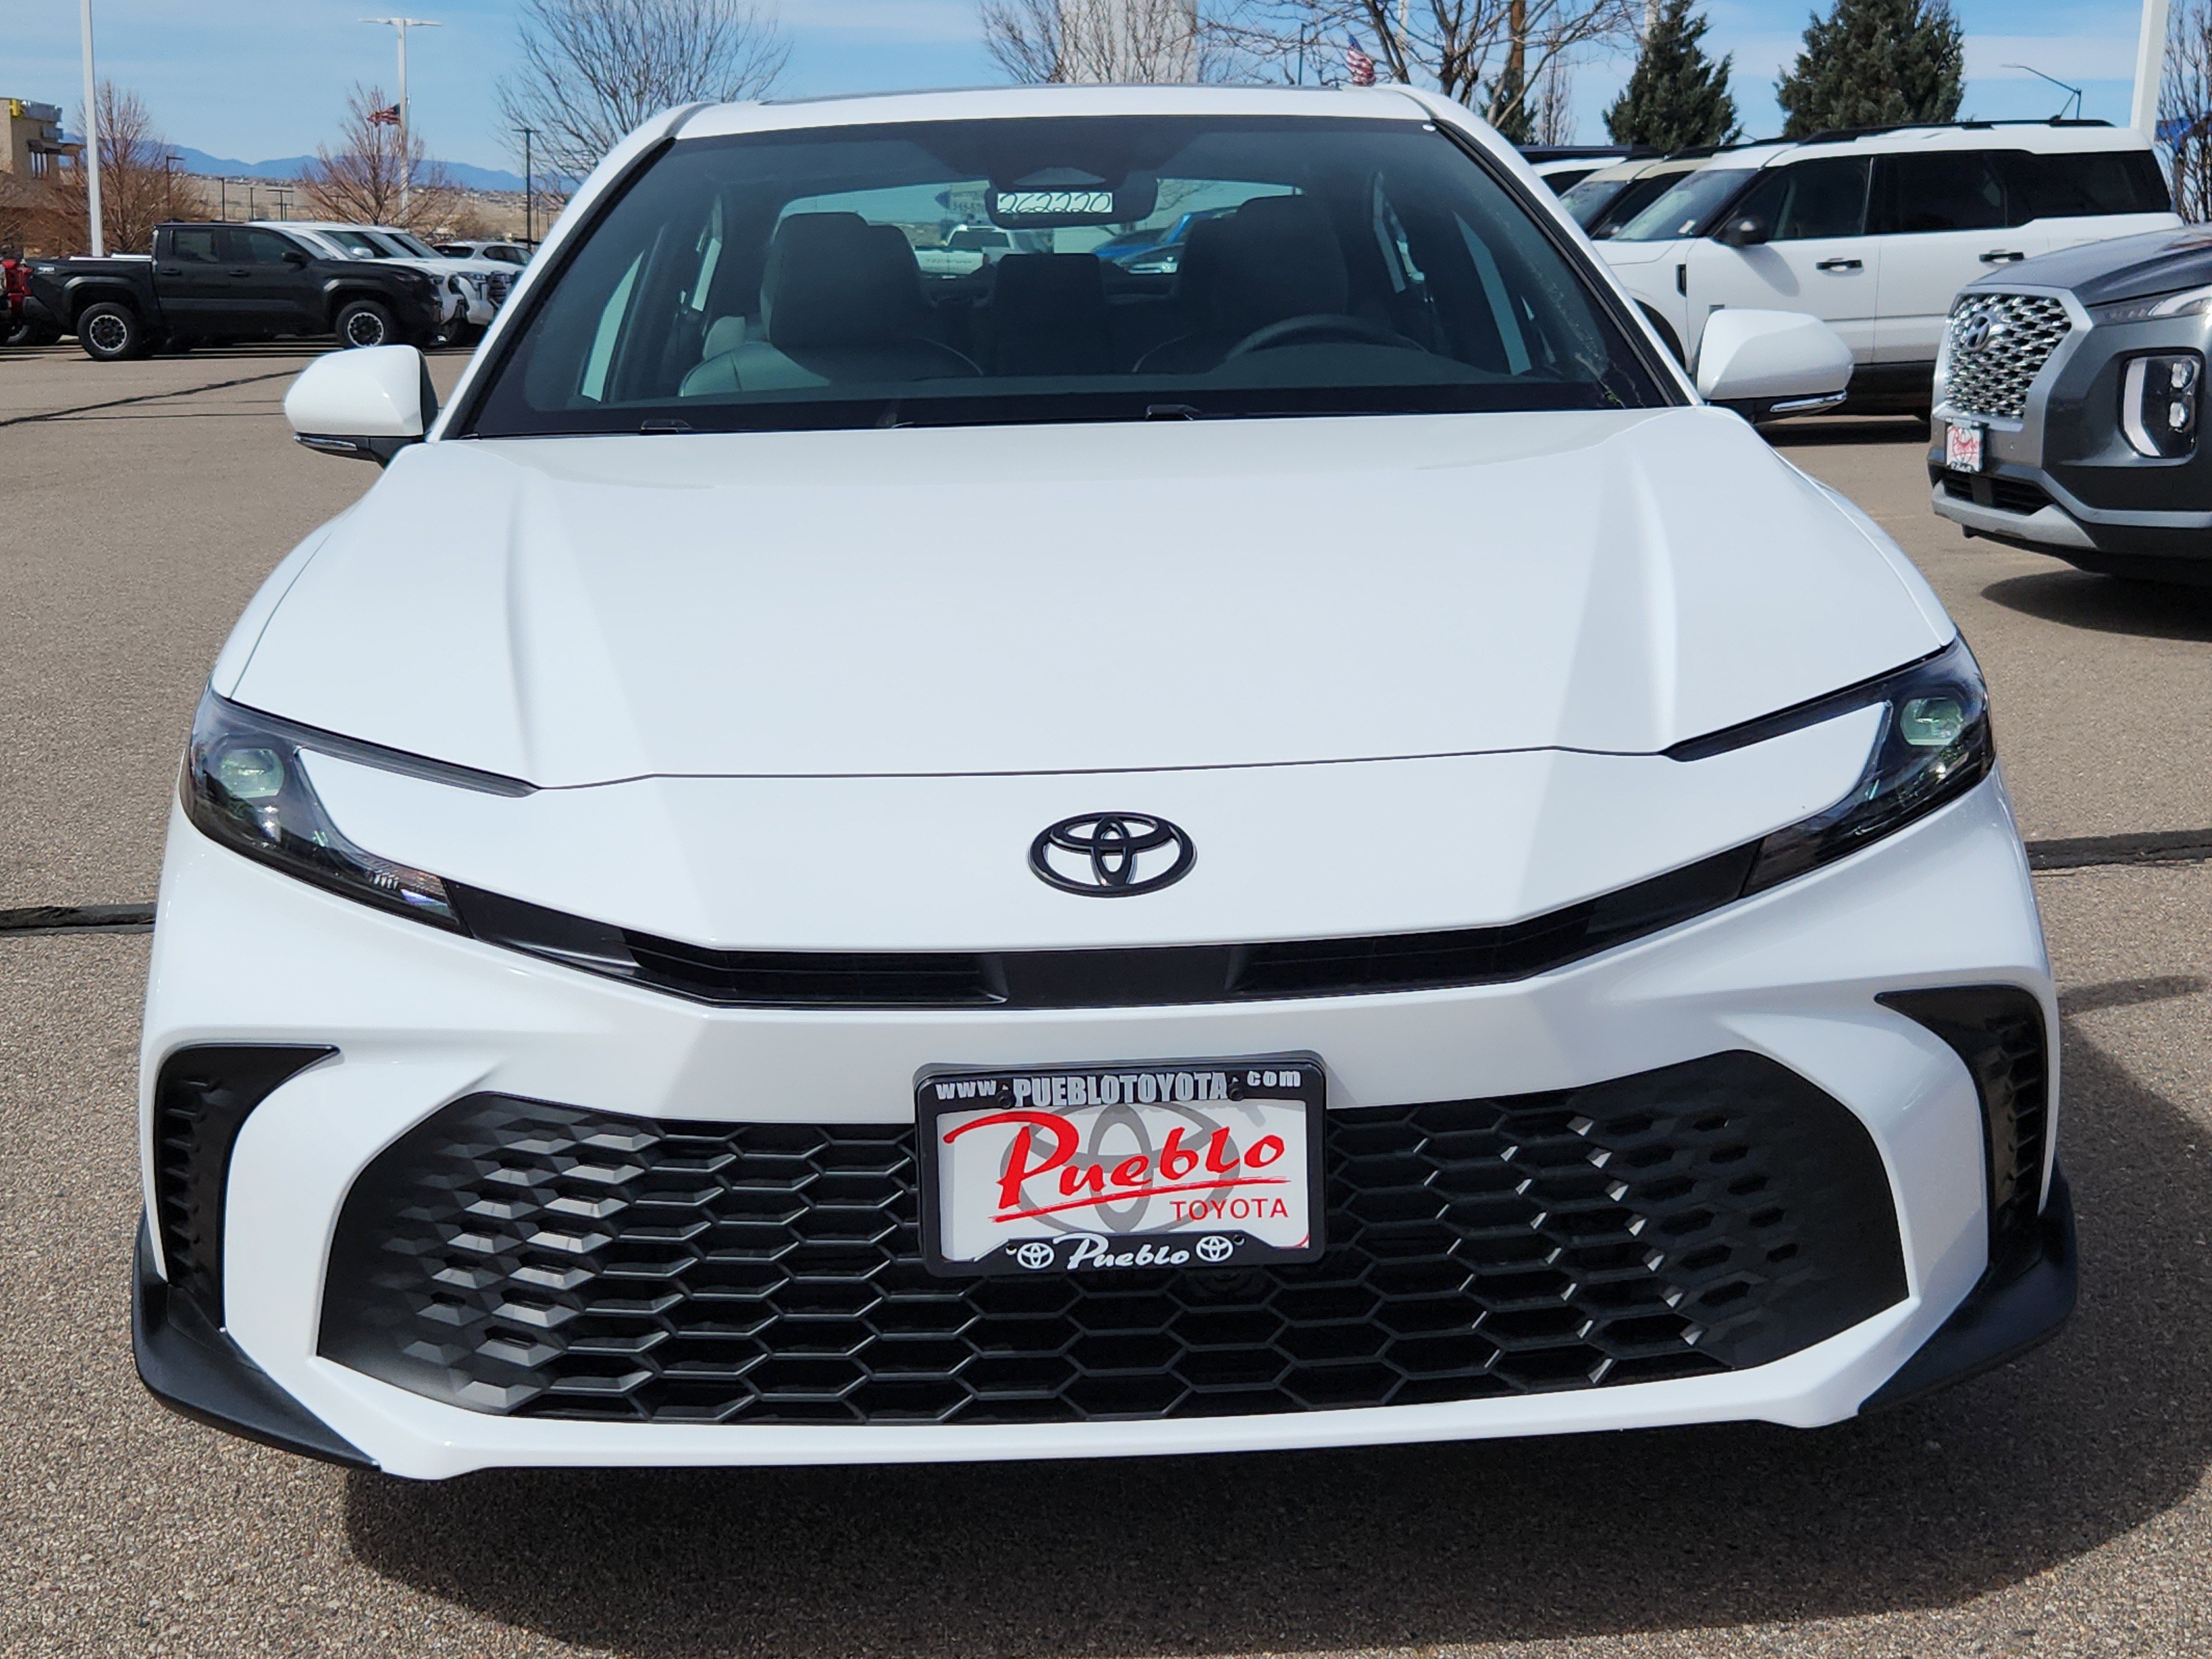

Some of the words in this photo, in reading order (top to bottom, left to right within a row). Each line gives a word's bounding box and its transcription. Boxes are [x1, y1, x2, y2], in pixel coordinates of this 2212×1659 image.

[999, 192, 1112, 213] 262220
[943, 1111, 1285, 1210] Pueblo
[1171, 1198, 1289, 1221] TOYOTA
[1052, 1232, 1190, 1270] Pueblo
